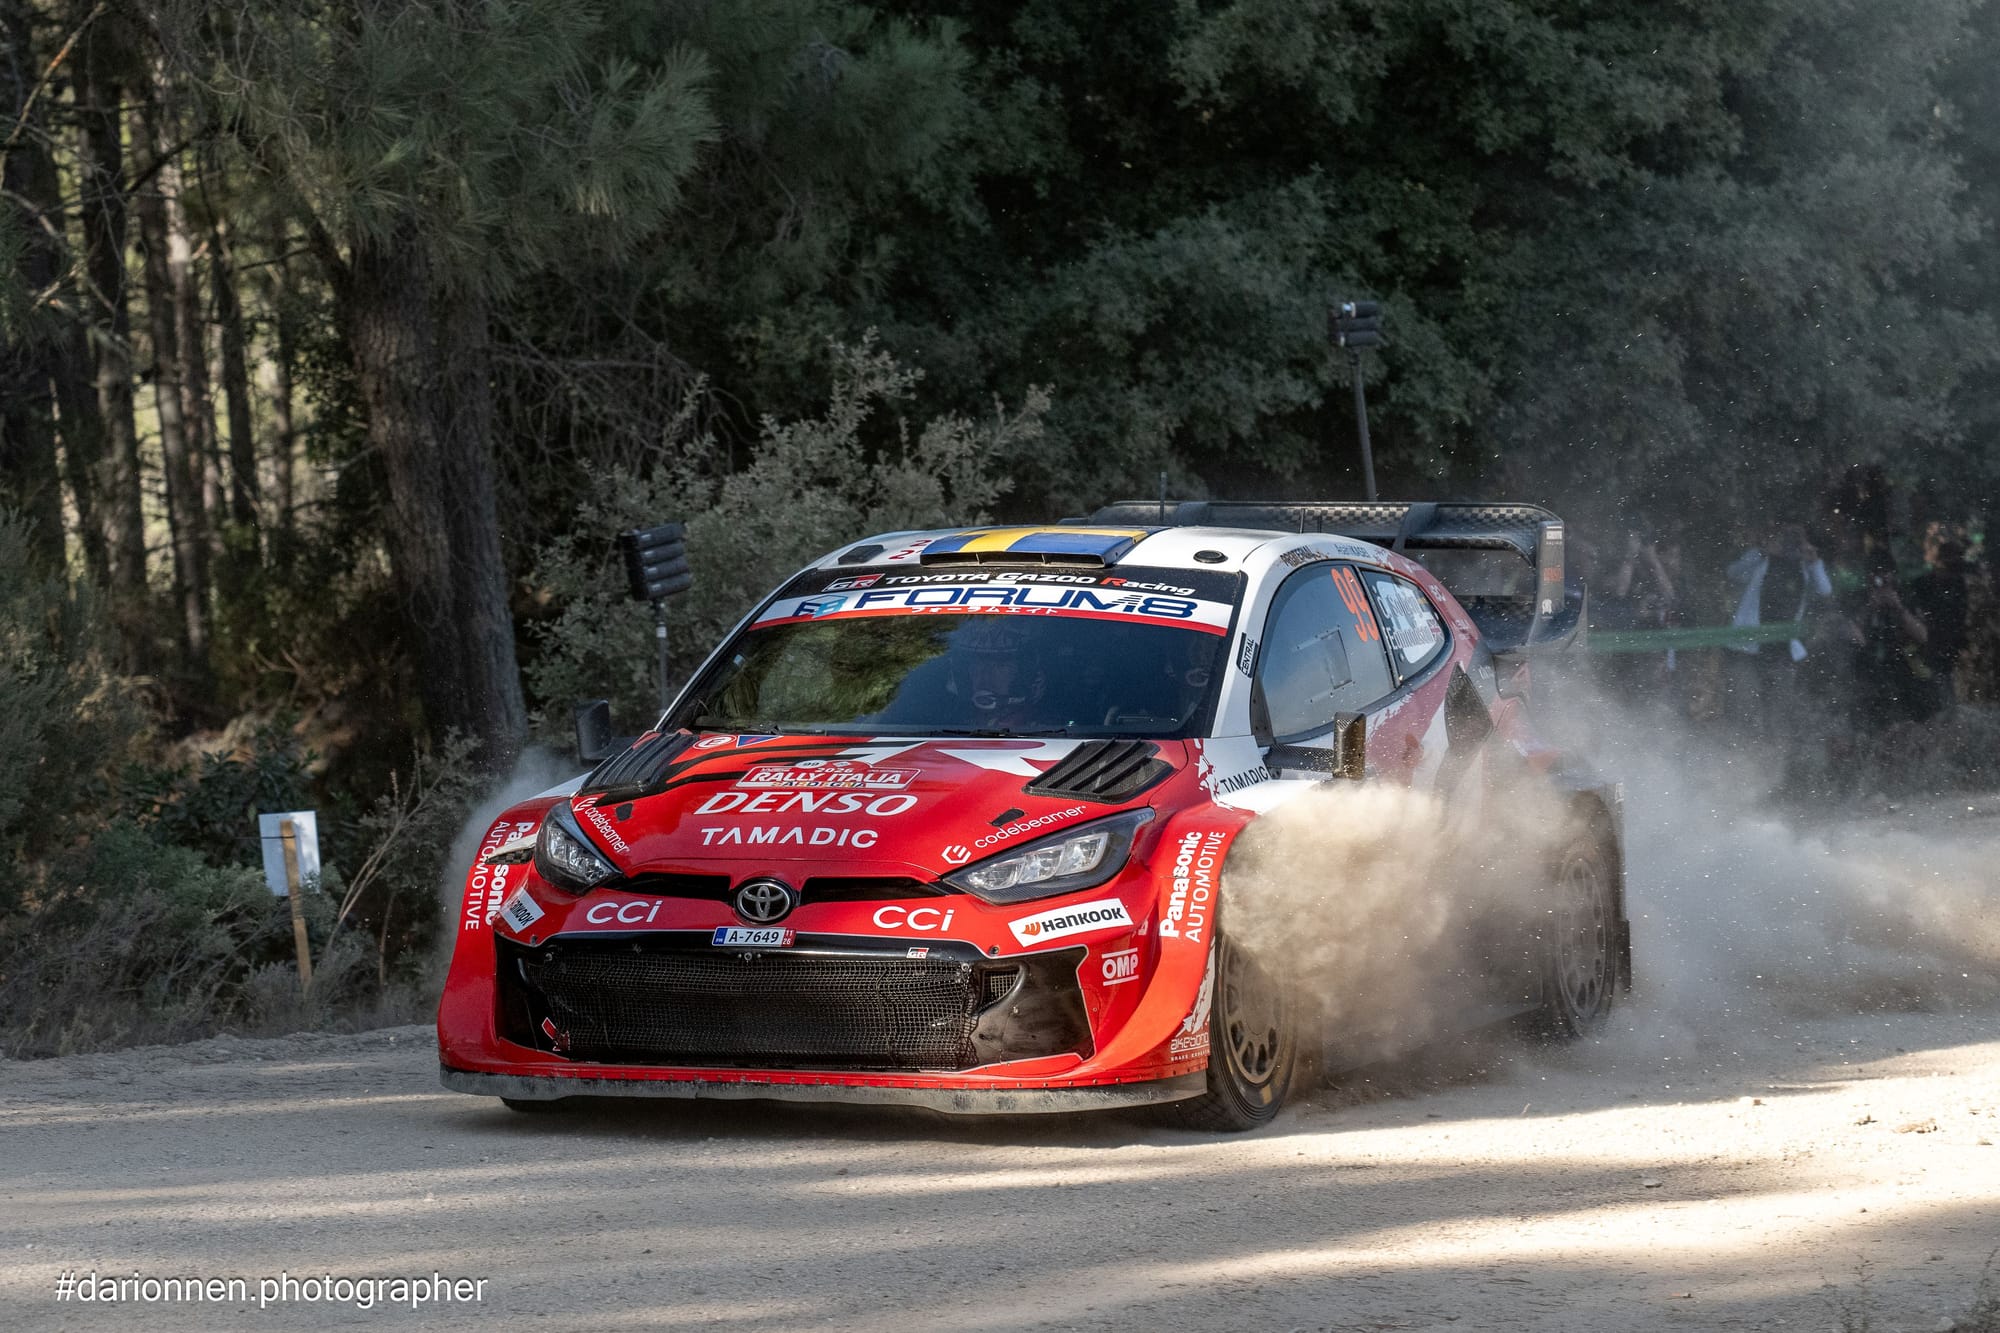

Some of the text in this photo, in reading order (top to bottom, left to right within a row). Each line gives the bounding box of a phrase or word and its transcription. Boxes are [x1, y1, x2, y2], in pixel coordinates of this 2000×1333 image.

[885, 573, 991, 585] TOYOTA
[995, 572, 1097, 584] GAZOO
[1100, 576, 1196, 596] Racing
[855, 587, 1198, 619] FORUM8
[1331, 567, 1379, 643] 99
[1239, 638, 1256, 676] CENTRAL
[750, 772, 901, 784] RALLY ITALIA
[1219, 765, 1270, 794] TAMADIC
[693, 791, 919, 817] DENSO
[583, 806, 630, 854] codebeamer
[700, 826, 879, 849] TAMADIC
[974, 804, 1086, 849] codebeamer
[1159, 831, 1203, 938] Panasonic
[1185, 831, 1227, 943] AUTOMOTIVE
[728, 930, 780, 943] A-7649
[1102, 953, 1139, 979] OMP
